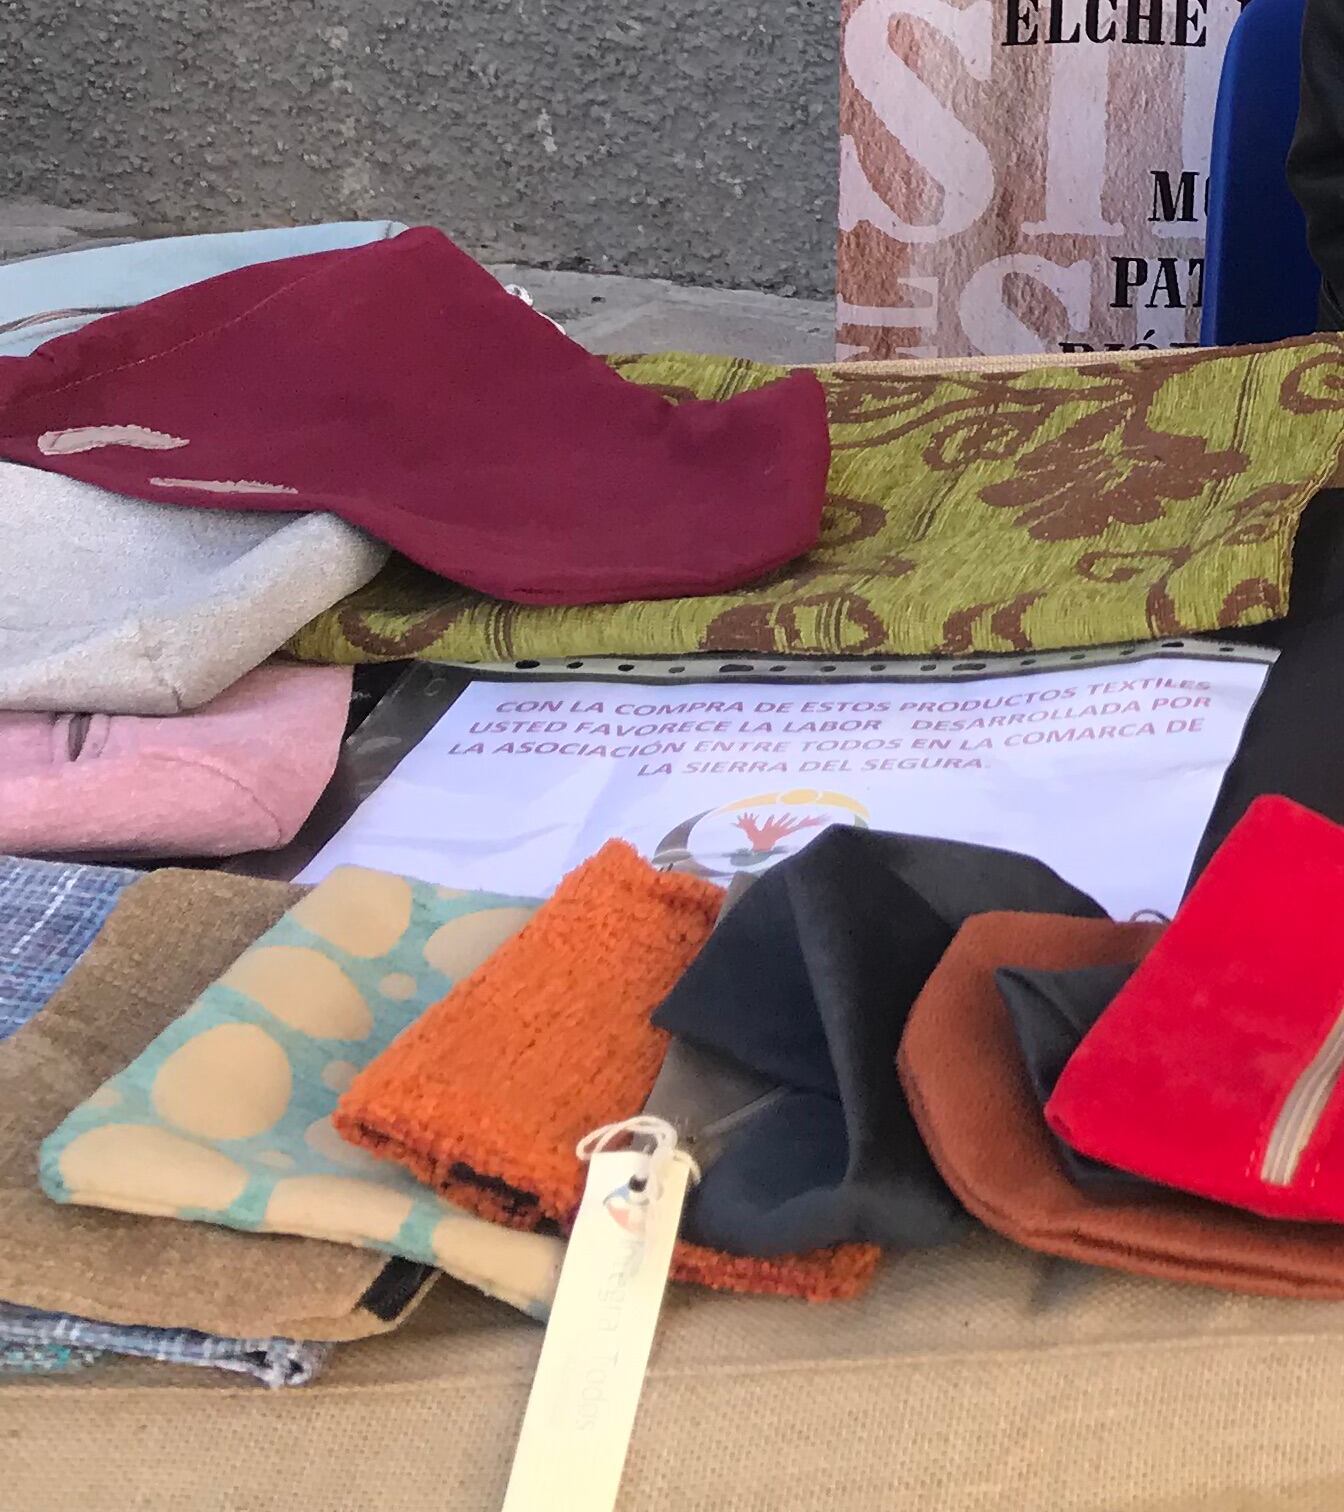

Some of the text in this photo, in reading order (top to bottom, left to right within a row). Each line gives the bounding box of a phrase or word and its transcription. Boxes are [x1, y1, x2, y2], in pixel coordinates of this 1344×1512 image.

[469, 695, 1213, 737] USTED FAVORECE LA LABOR DESARROLLADA POR
[496, 700, 564, 714] CON
[569, 700, 605, 714] LA
[614, 700, 745, 717] COMPRA
[753, 701, 794, 714] DE
[800, 700, 890, 714] ESTOS
[899, 686, 1077, 713] PRODUCTOS
[448, 717, 1206, 759] LA ASOCIACIÓN ENTRE TODOS EN LA COMARCA DE
[636, 762, 674, 778] LA
[682, 760, 789, 775] SIERRA
[797, 760, 853, 774] DEL
